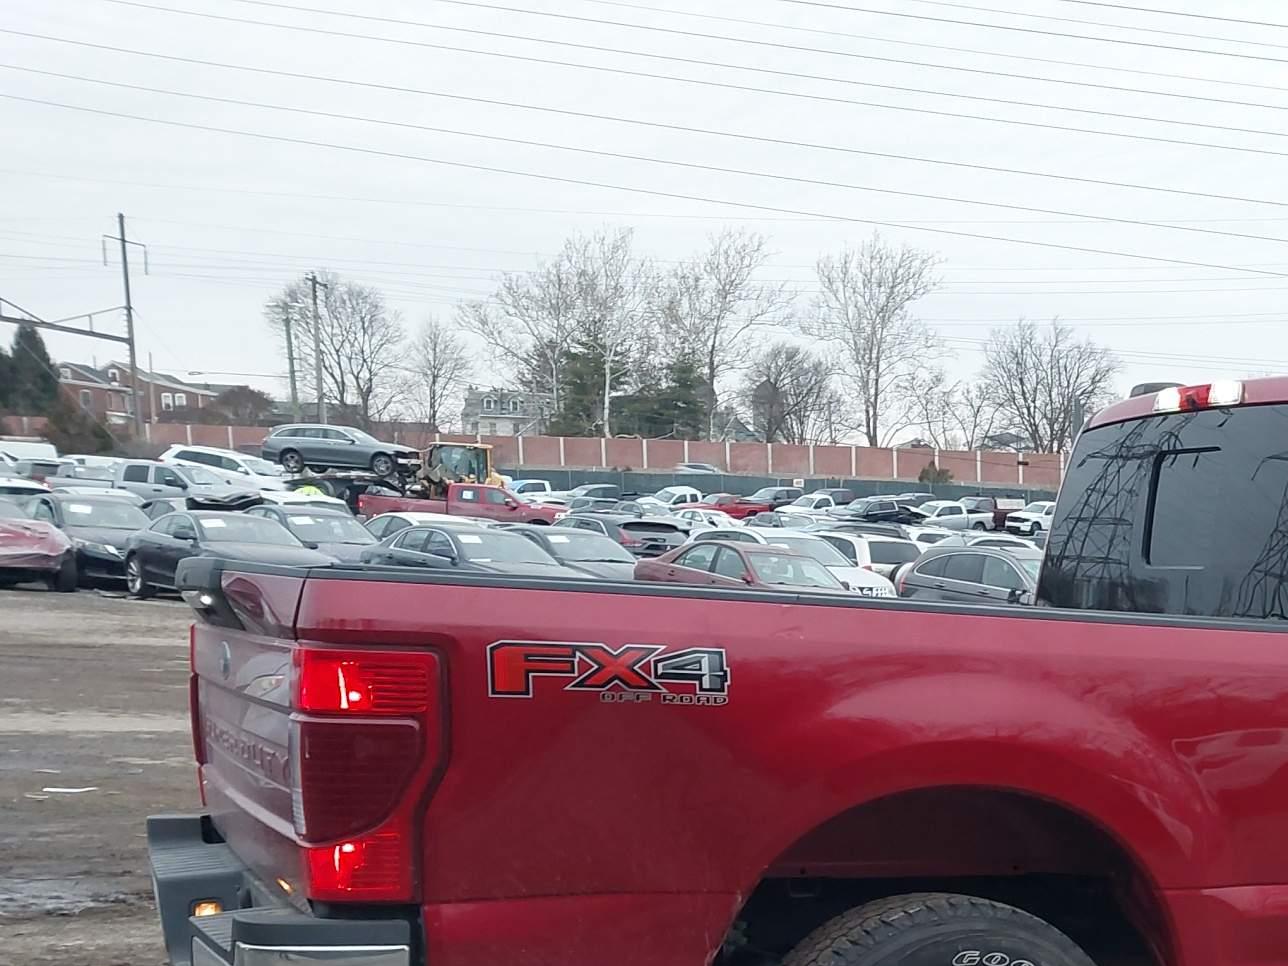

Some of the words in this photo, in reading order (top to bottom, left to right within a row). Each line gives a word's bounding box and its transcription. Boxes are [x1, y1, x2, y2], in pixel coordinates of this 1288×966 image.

[486, 640, 731, 698] FX4
[600, 691, 652, 703] OFF
[661, 694, 729, 706] ROAD
